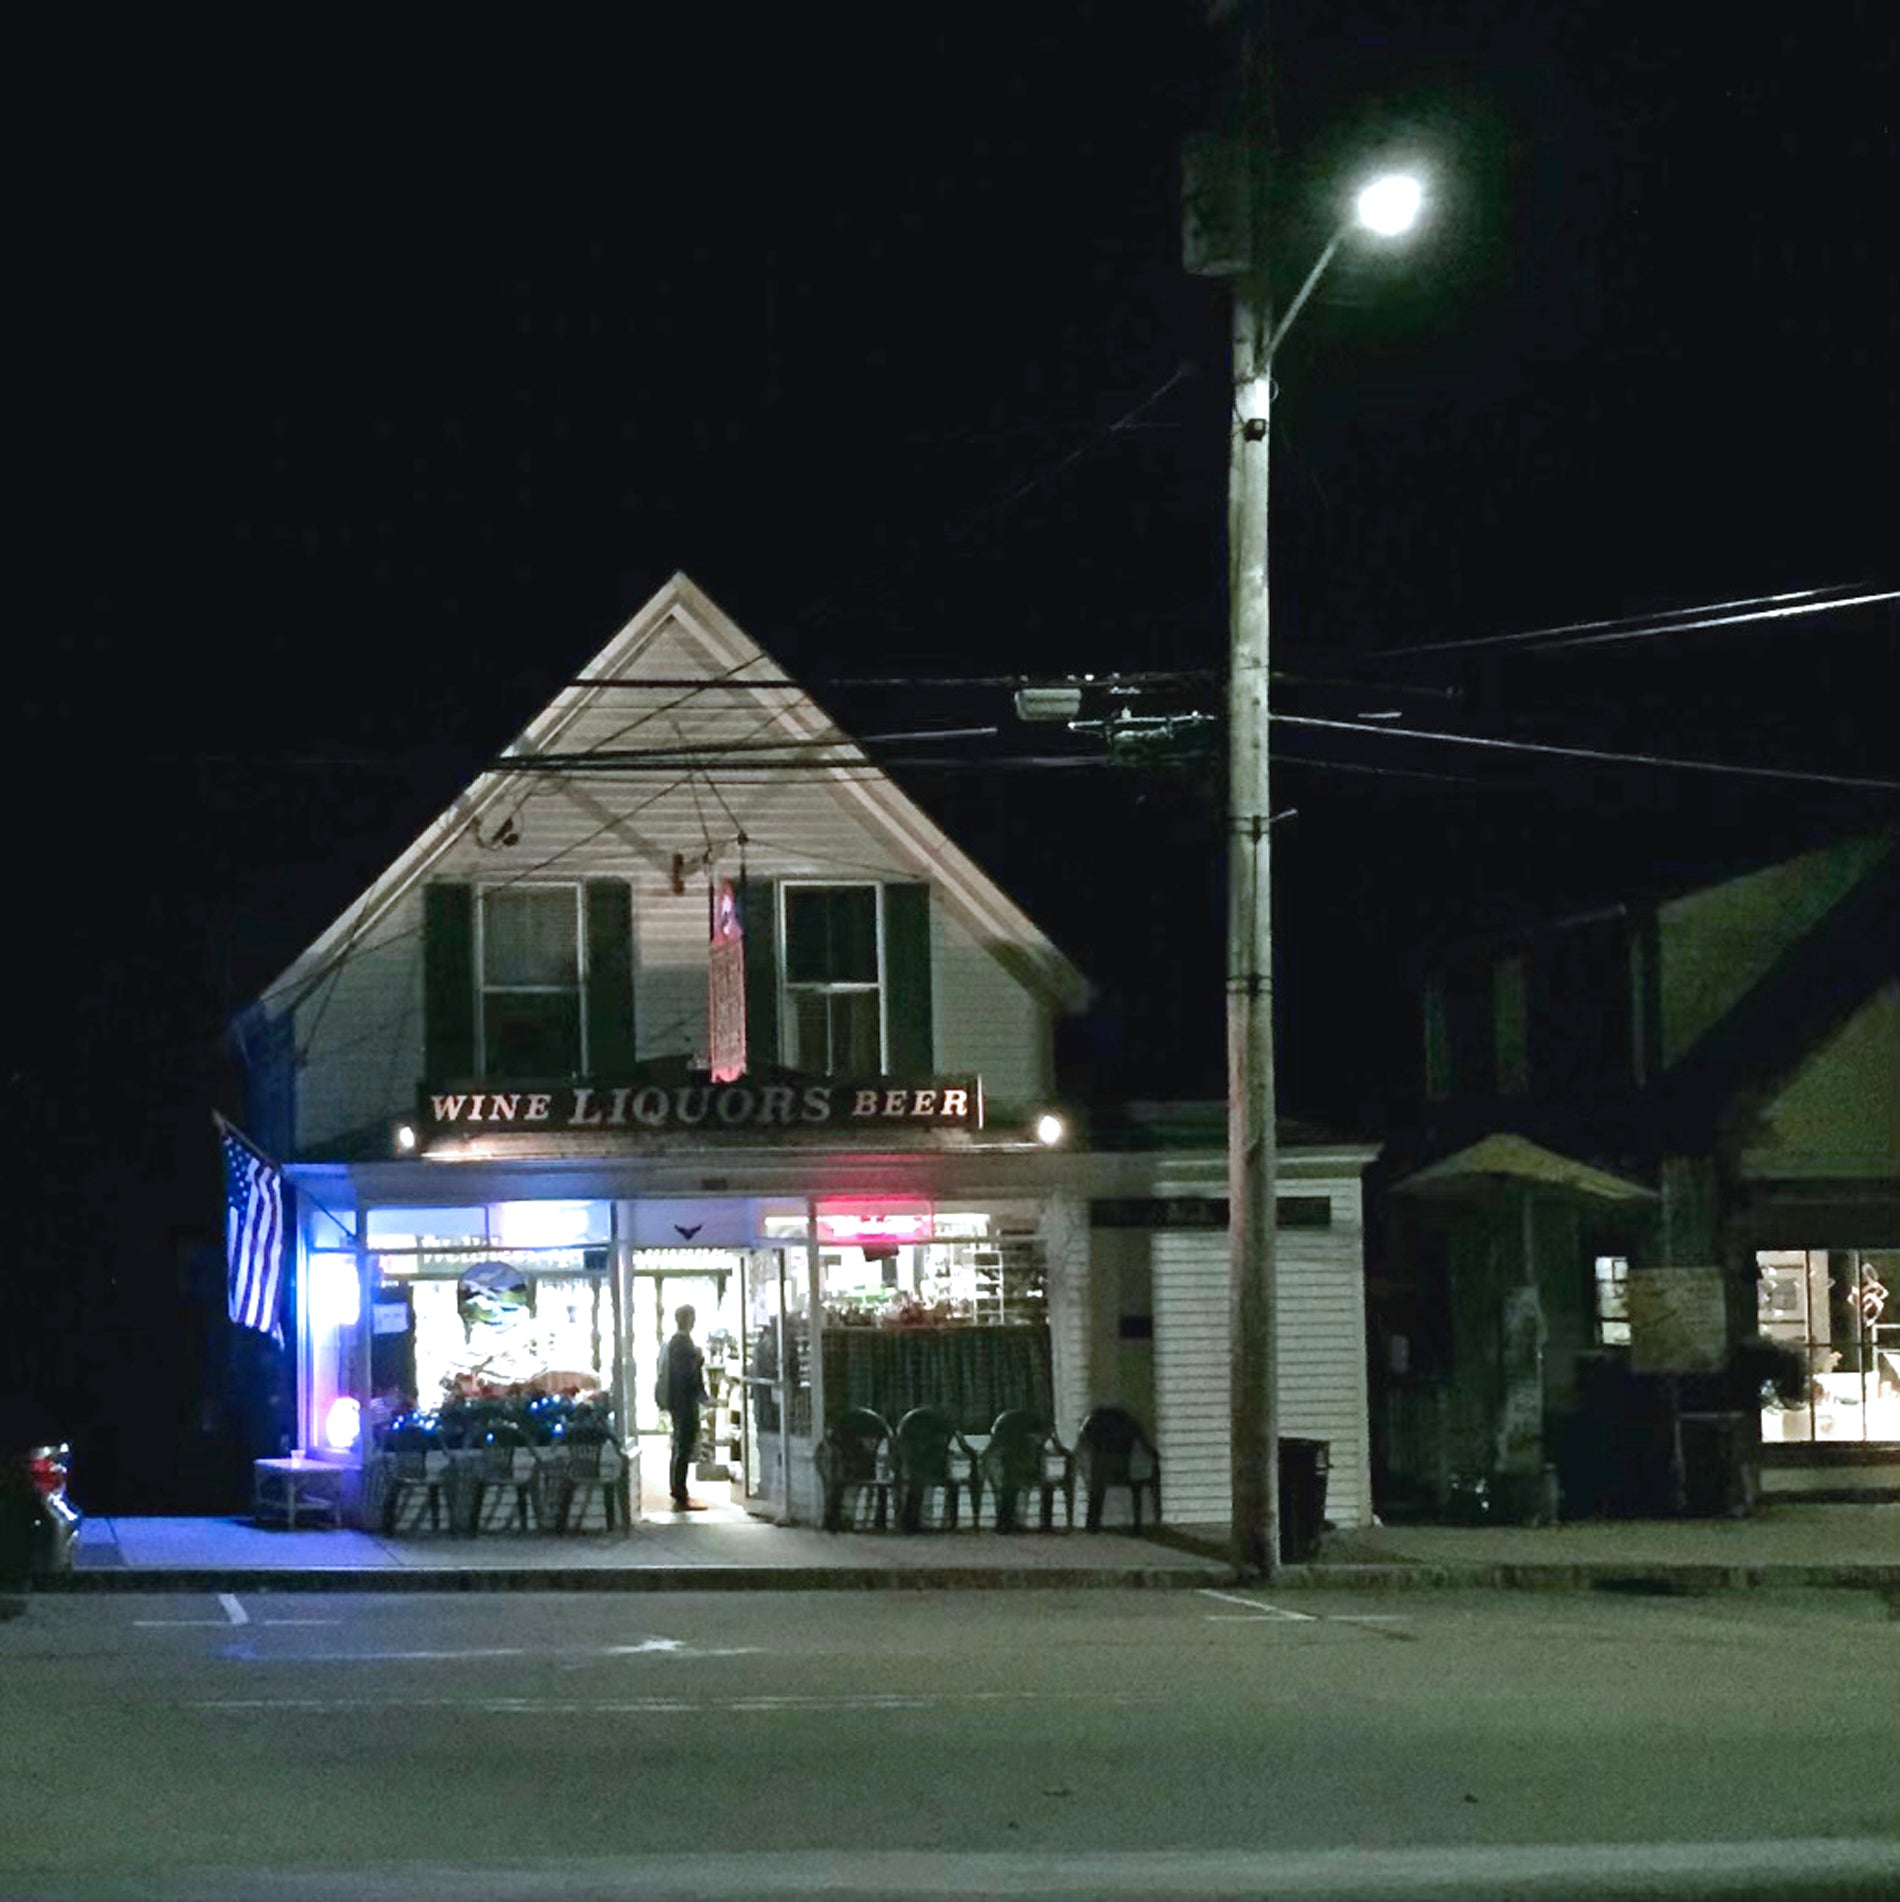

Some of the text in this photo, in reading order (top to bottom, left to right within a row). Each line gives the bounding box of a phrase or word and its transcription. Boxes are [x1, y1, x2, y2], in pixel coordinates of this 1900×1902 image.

[431, 1087, 968, 1126] WINE LIQUORS BEER
